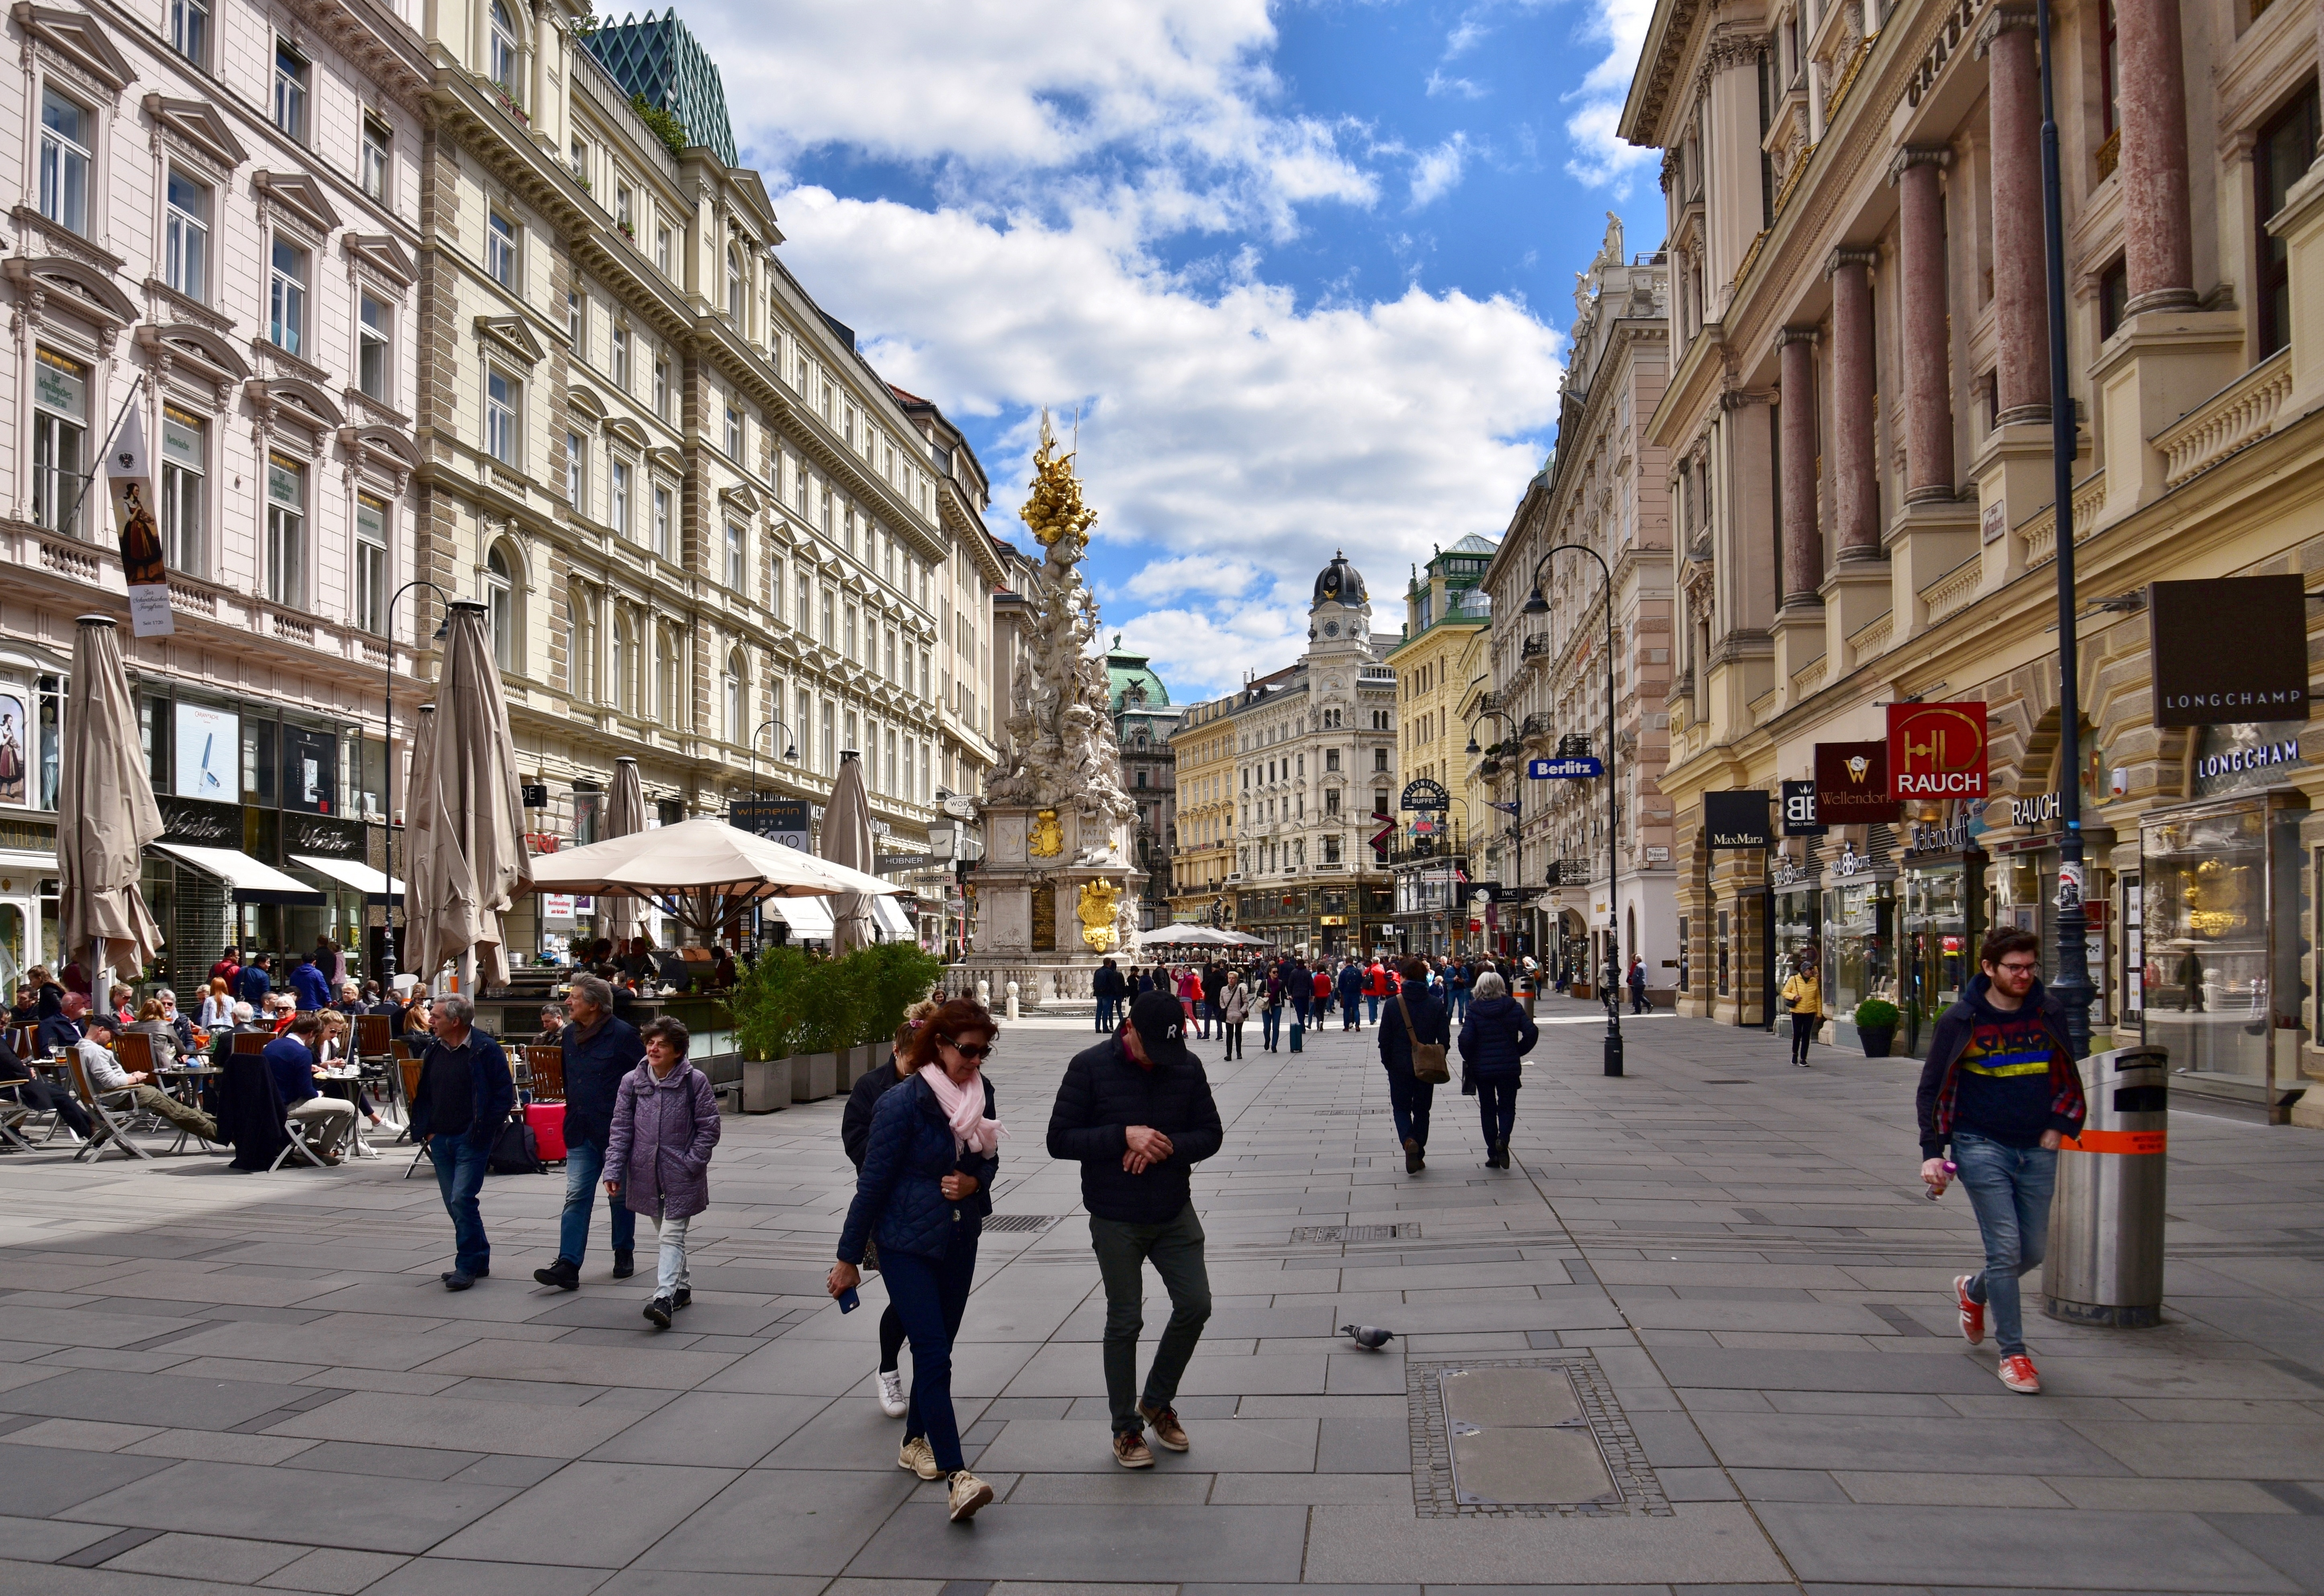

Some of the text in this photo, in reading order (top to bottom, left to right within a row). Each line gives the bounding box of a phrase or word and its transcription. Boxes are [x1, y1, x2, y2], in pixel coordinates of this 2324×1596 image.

[51, 371, 61, 384] Zur
[143, 589, 153, 597] Zur
[138, 603, 164, 611] Jungfrau
[2166, 690, 2301, 709] LONGCHAMP
[2199, 739, 2299, 778] LONGCHAM
[1537, 761, 1591, 775] Berlitz
[1898, 773, 1980, 792] RAUCH
[1404, 781, 1446, 802] TRZESNIEWSKI
[737, 807, 800, 815] wienerin
[2012, 792, 2062, 826] RAUCH
[1713, 833, 1763, 844] MaxMara
[1910, 814, 1968, 852] Wellendorff
[1831, 860, 1843, 873] BIJOU
[1166, 1024, 1177, 1039] R
